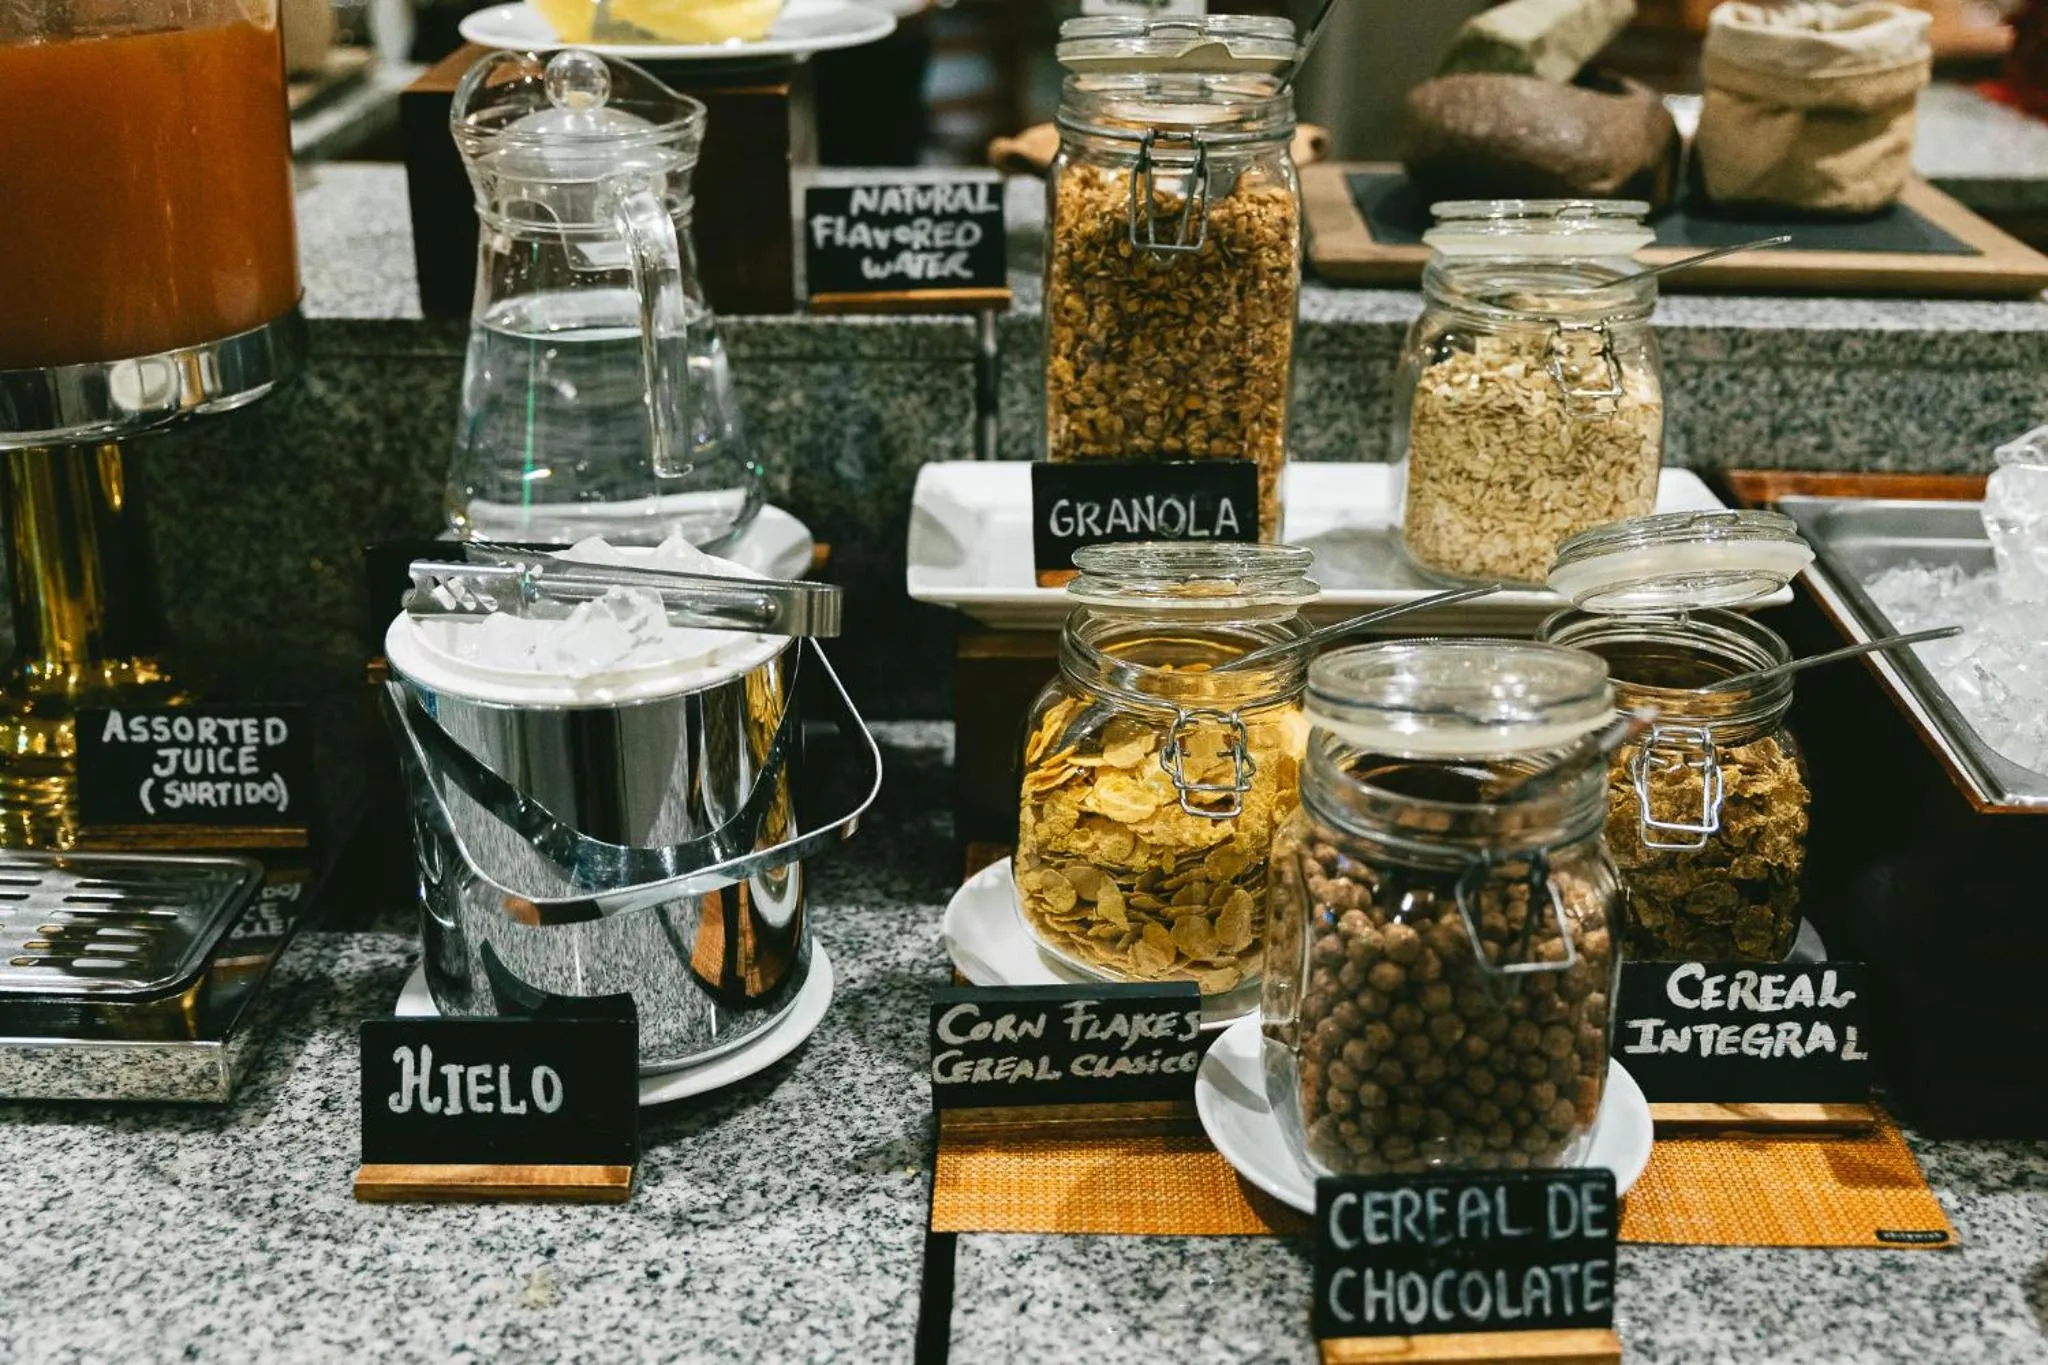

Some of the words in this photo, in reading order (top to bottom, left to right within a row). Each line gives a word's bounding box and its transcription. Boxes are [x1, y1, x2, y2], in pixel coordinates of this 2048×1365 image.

[850, 183, 999, 216] NATURAL
[1049, 495, 1240, 538] GRANOLA
[102, 709, 288, 746] ASSORTED
[152, 746, 260, 777] JUICE
[1665, 962, 1856, 1012] CEREAL
[936, 1003, 1048, 1045] CORN
[1060, 1000, 1201, 1050] FLAKES
[1624, 1017, 1868, 1061] INTEGRAL
[388, 1043, 564, 1116] HIELO
[931, 1049, 1063, 1084] CEREAL
[1328, 1186, 1534, 1250] CEREAL
[1546, 1182, 1609, 1240] DE
[1328, 1259, 1612, 1325] CHOCOLATE
